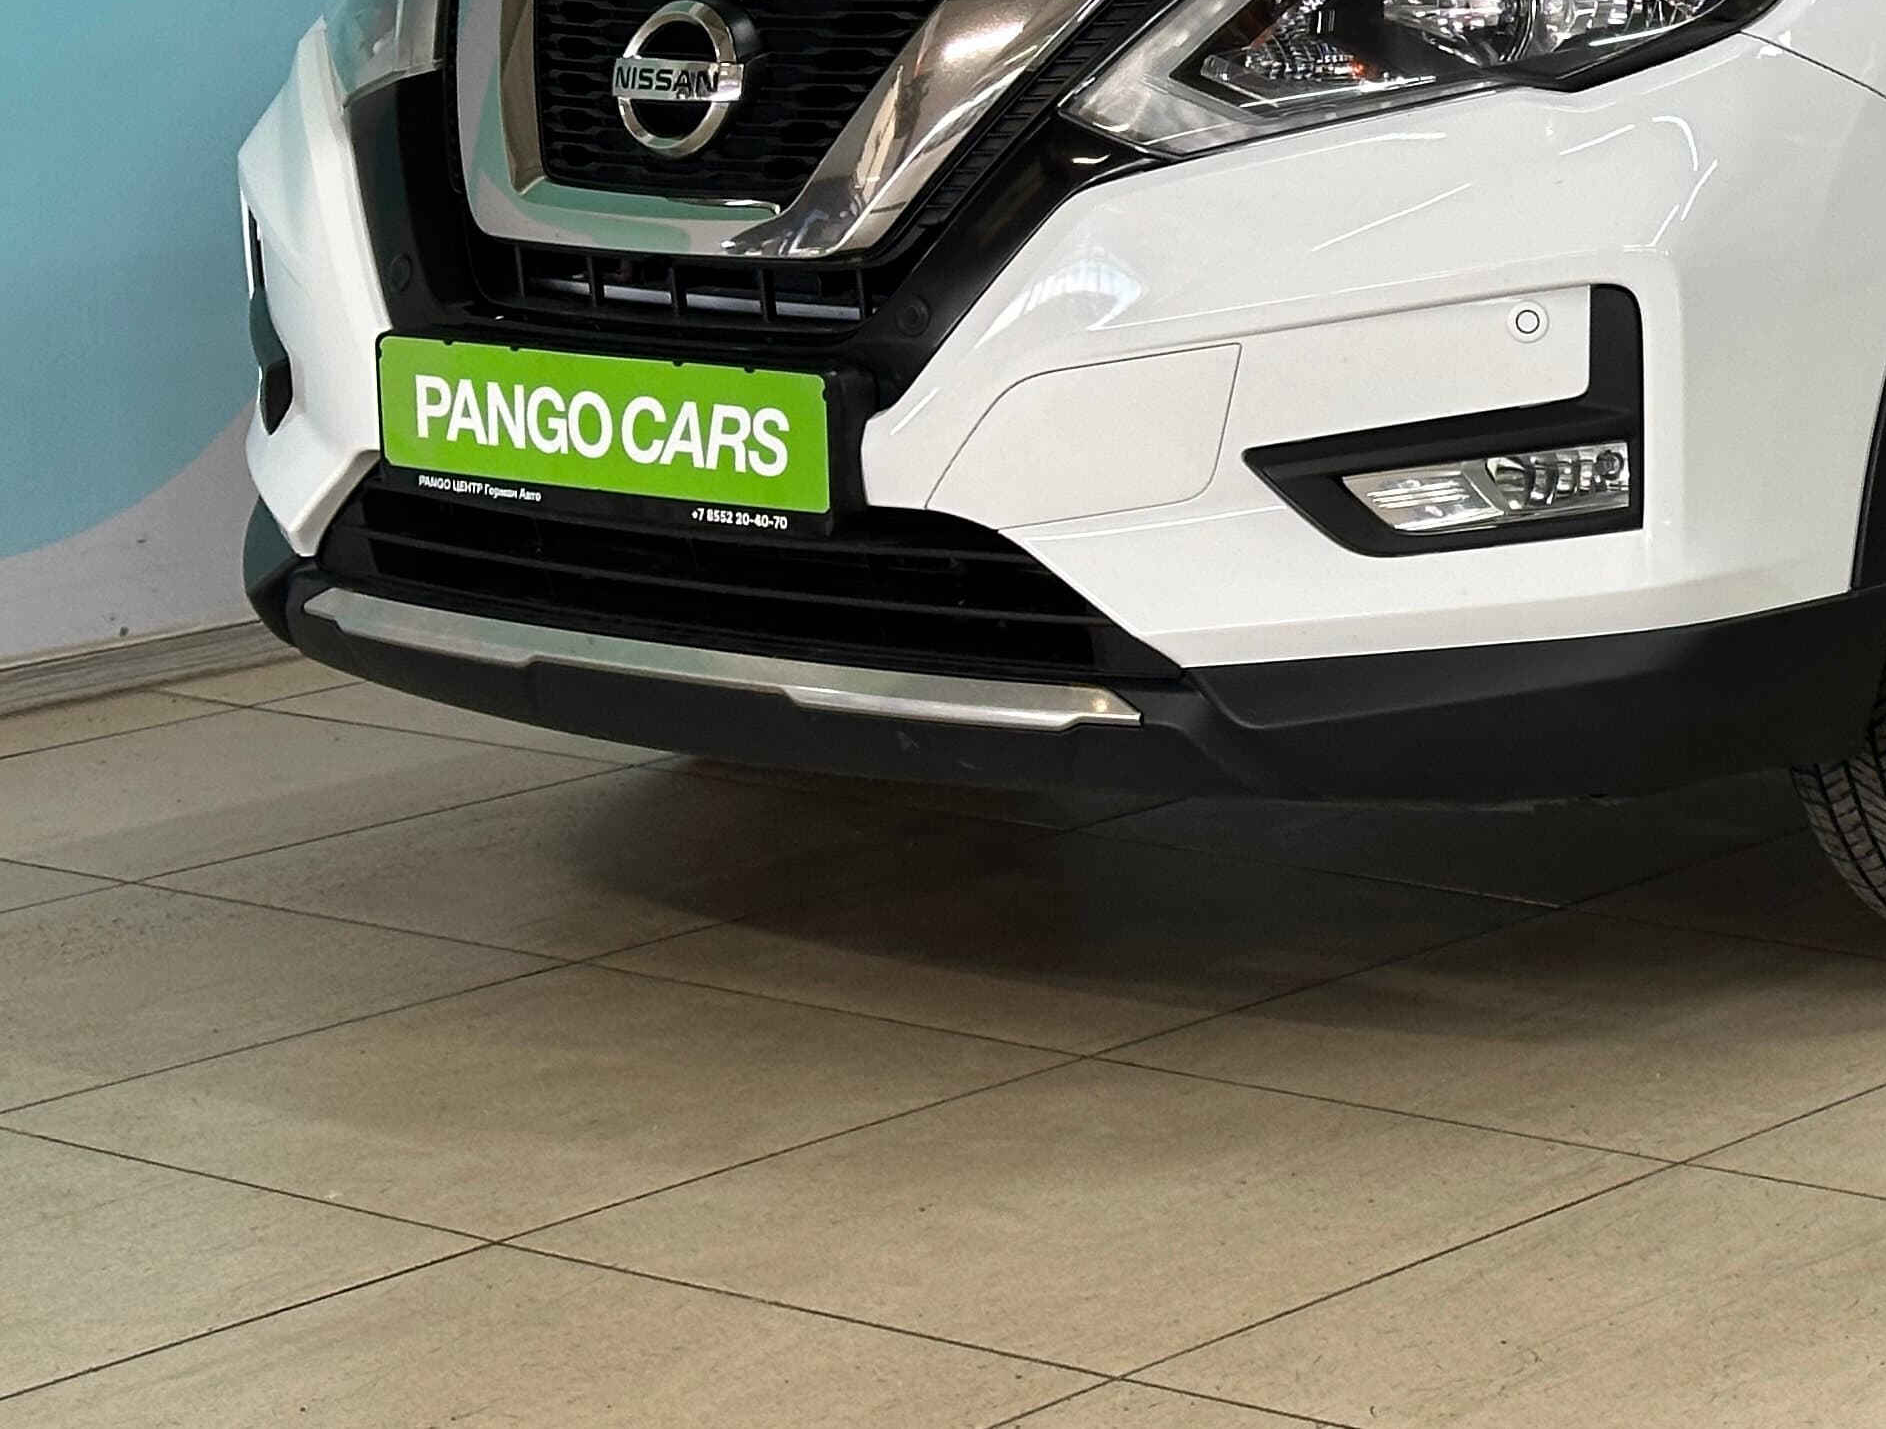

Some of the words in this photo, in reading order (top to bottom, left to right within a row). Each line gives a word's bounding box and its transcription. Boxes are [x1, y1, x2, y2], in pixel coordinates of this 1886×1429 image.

[614, 66, 720, 93] NISSAN
[415, 374, 613, 459] PANGO
[621, 396, 790, 477] CARS
[453, 479, 483, 494] ЦЕНТР
[706, 509, 733, 524] 8552
[735, 512, 788, 530] 20-40-70
